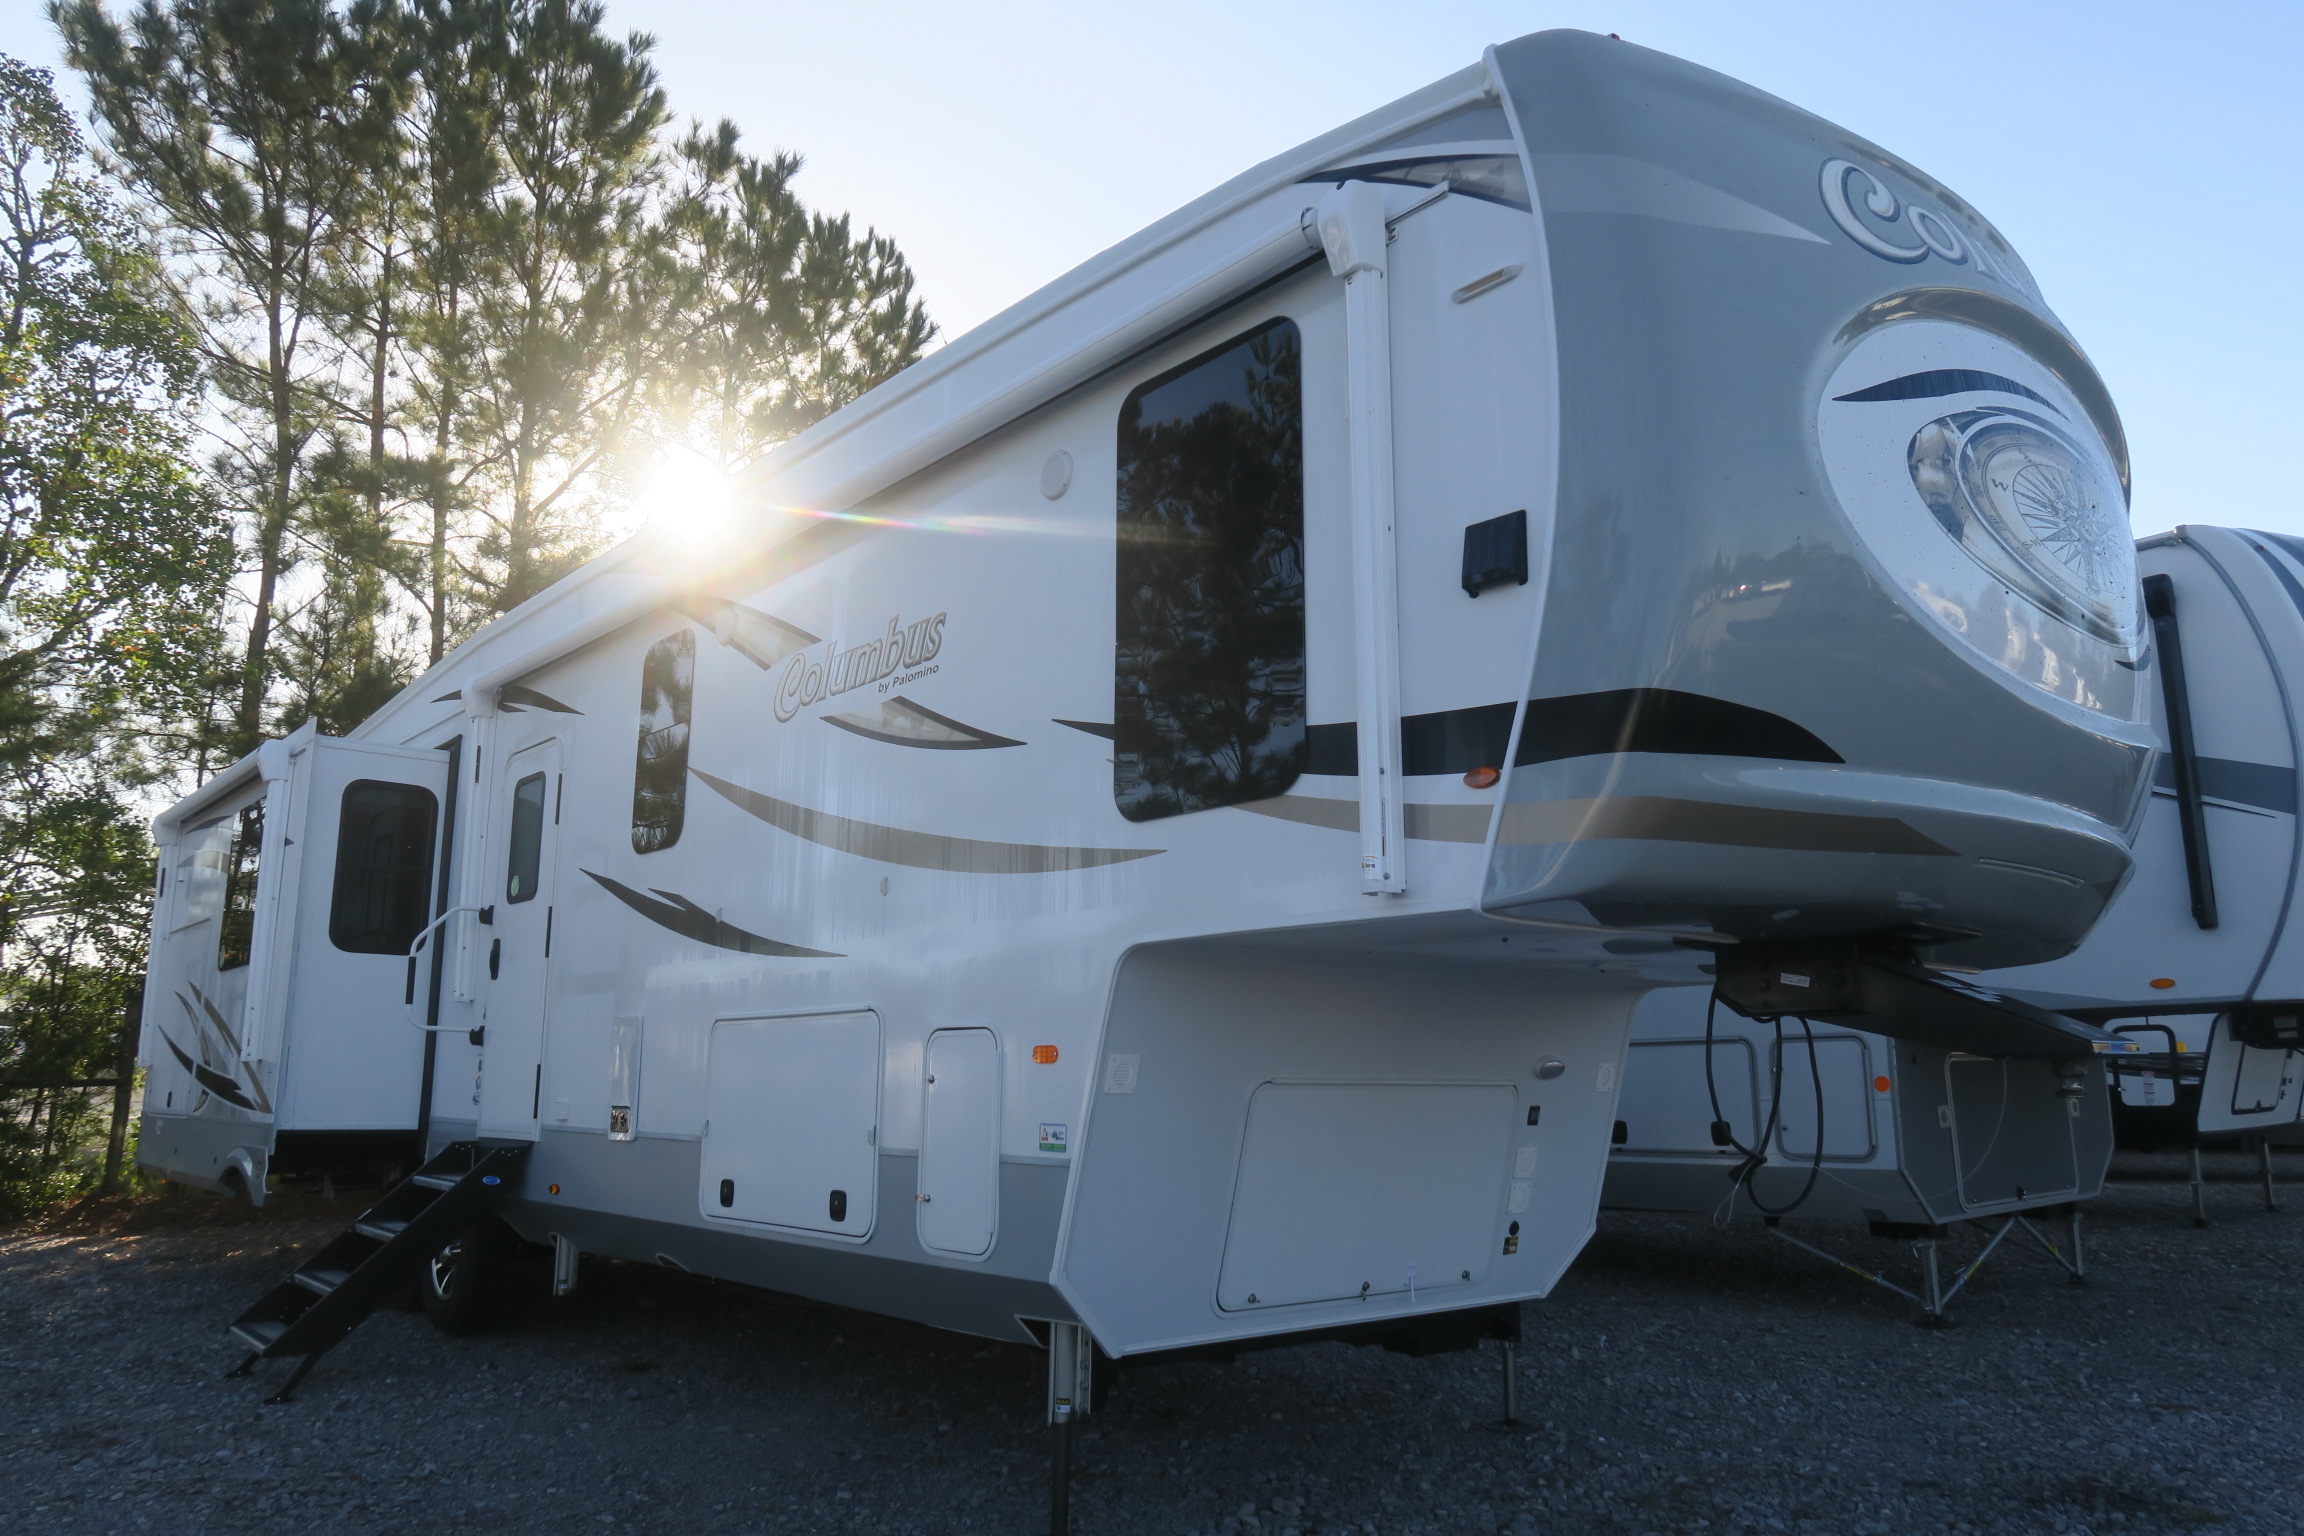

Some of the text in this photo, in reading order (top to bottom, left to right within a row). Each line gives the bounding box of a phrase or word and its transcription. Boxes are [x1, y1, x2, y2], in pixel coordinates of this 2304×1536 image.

[774, 612, 947, 723] Columbus
[878, 664, 939, 693] by Palomino
